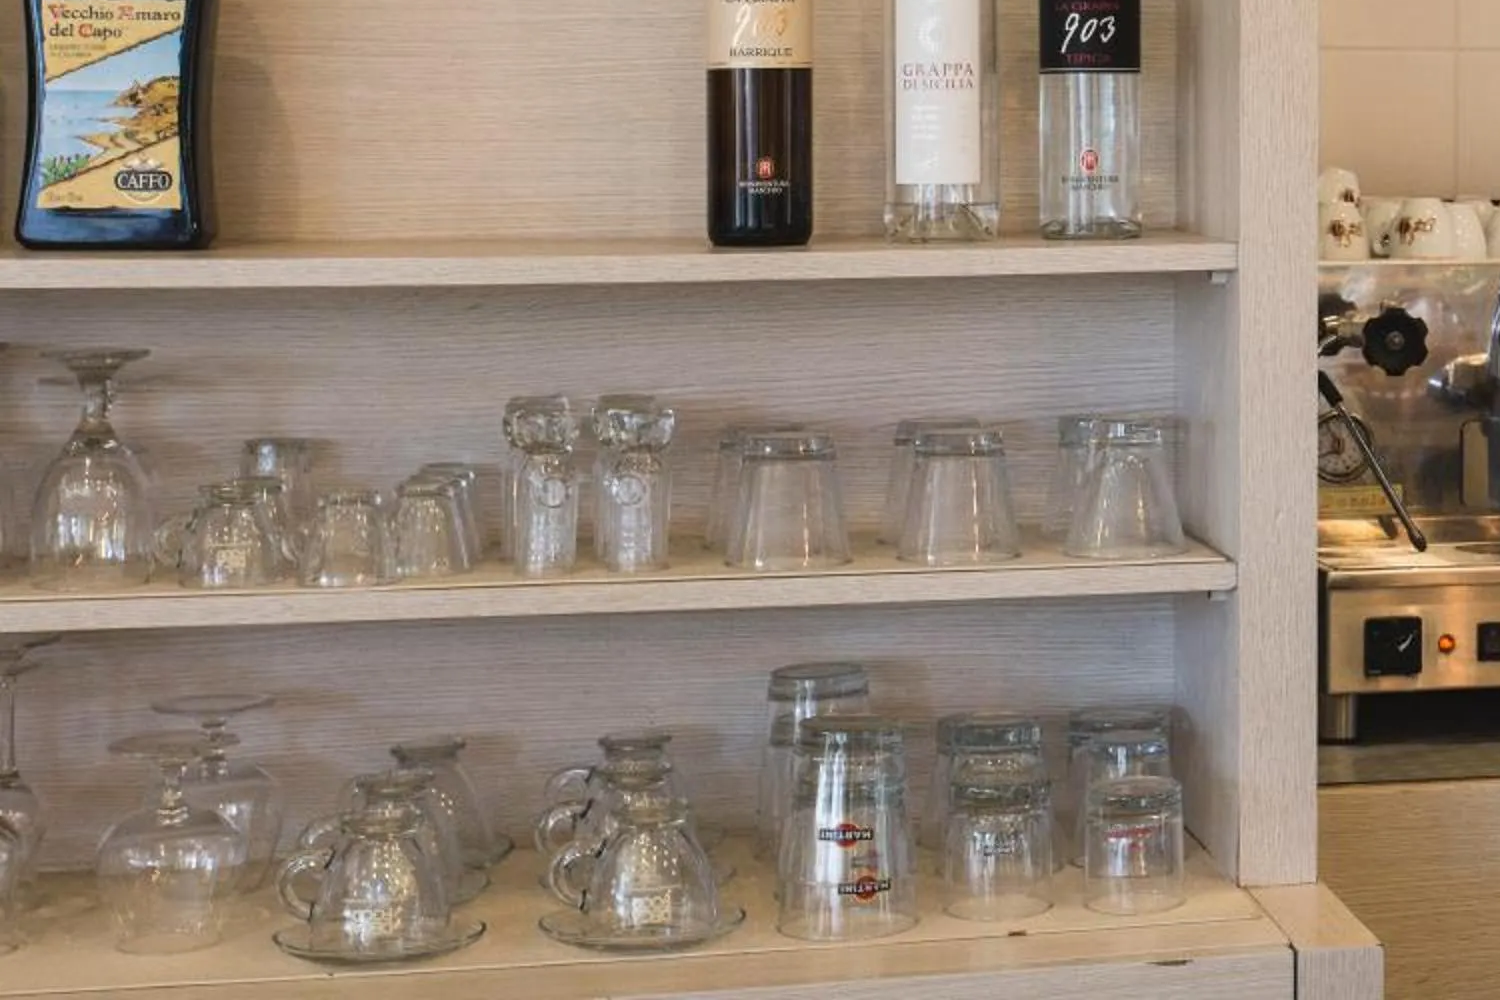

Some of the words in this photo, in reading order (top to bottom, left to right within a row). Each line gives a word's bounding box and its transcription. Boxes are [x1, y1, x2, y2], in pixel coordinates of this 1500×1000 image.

[48, 4, 114, 20] Vecchio
[118, 6, 181, 21] Amaro
[49, 23, 74, 37] del
[78, 23, 122, 40] Capo
[1061, 12, 1116, 54] 903
[902, 63, 975, 78] GRAPPA
[117, 173, 170, 190] CAFFO
